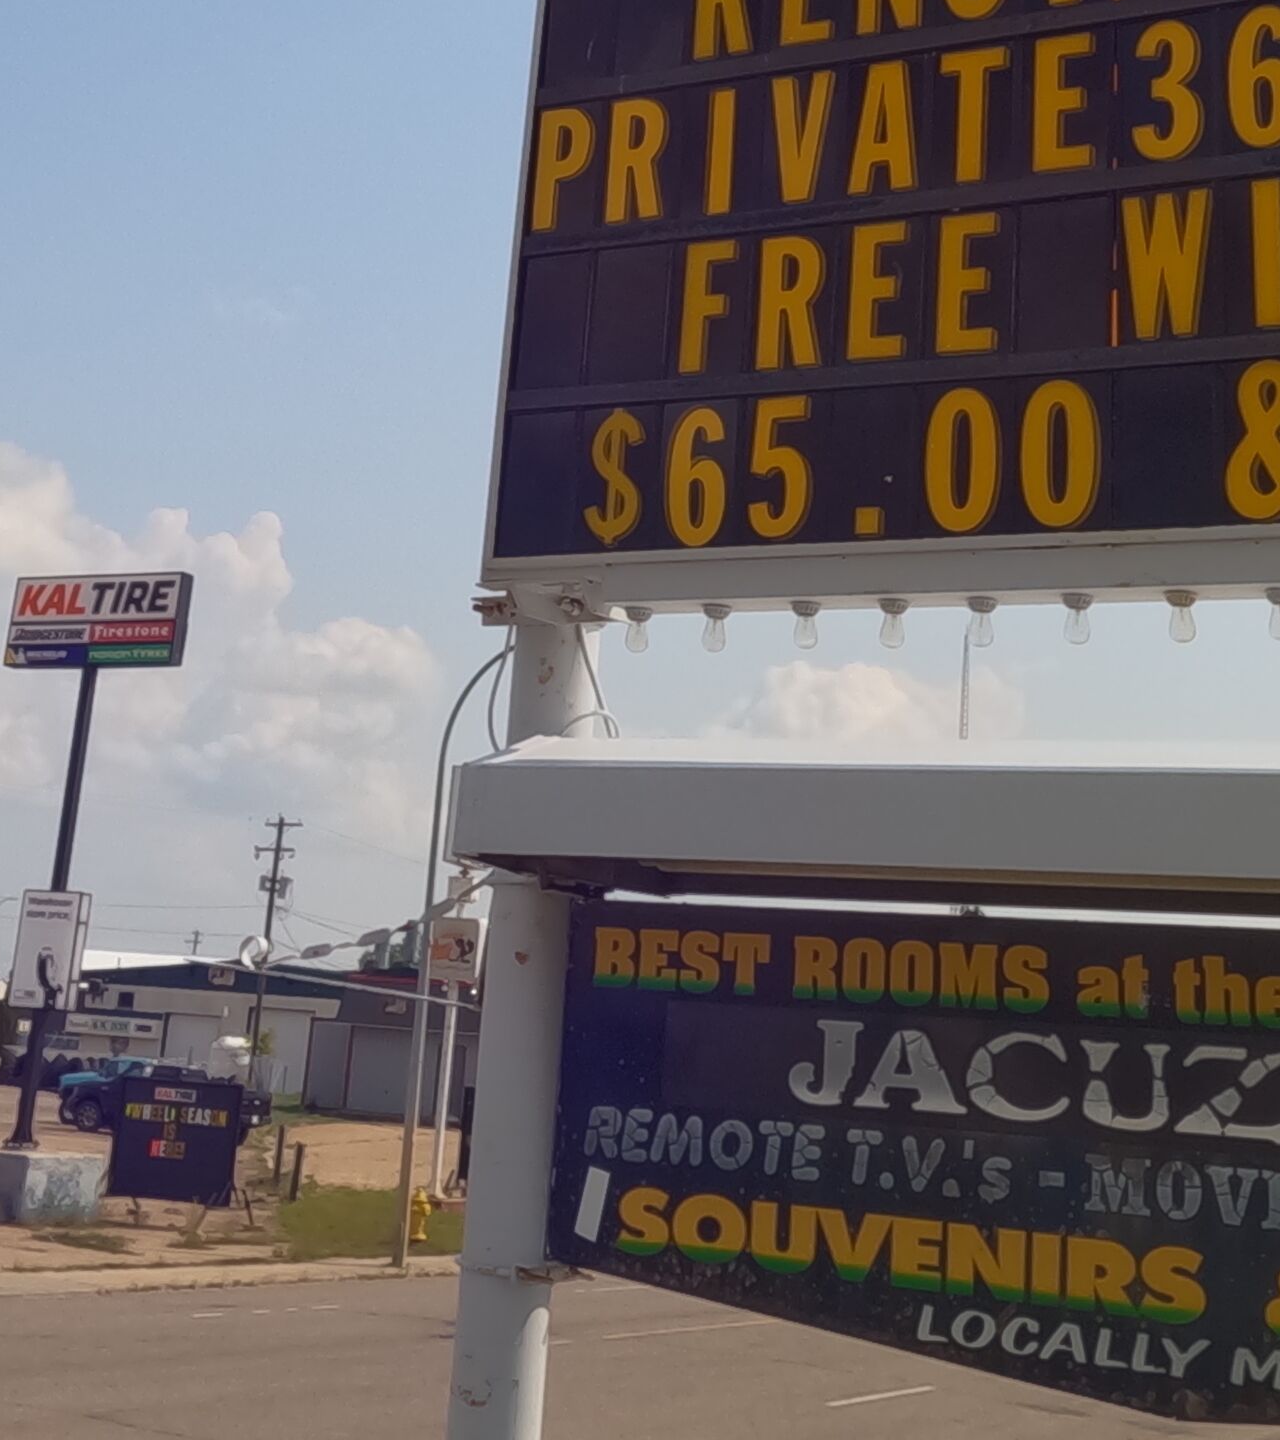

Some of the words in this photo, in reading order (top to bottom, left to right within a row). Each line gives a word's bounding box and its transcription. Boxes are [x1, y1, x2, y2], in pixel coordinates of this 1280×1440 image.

[679, 211, 1000, 374] FREE
[584, 380, 1101, 547] $65.00
[94, 624, 170, 640] Firestone
[593, 926, 771, 996] BEST
[792, 935, 1050, 1014] ROOMS
[1076, 954, 1150, 1018] at
[584, 1105, 826, 1182] REMOTE
[616, 1187, 1207, 1325] SOUVENIRS
[917, 1304, 1212, 1378] LOCALLY
